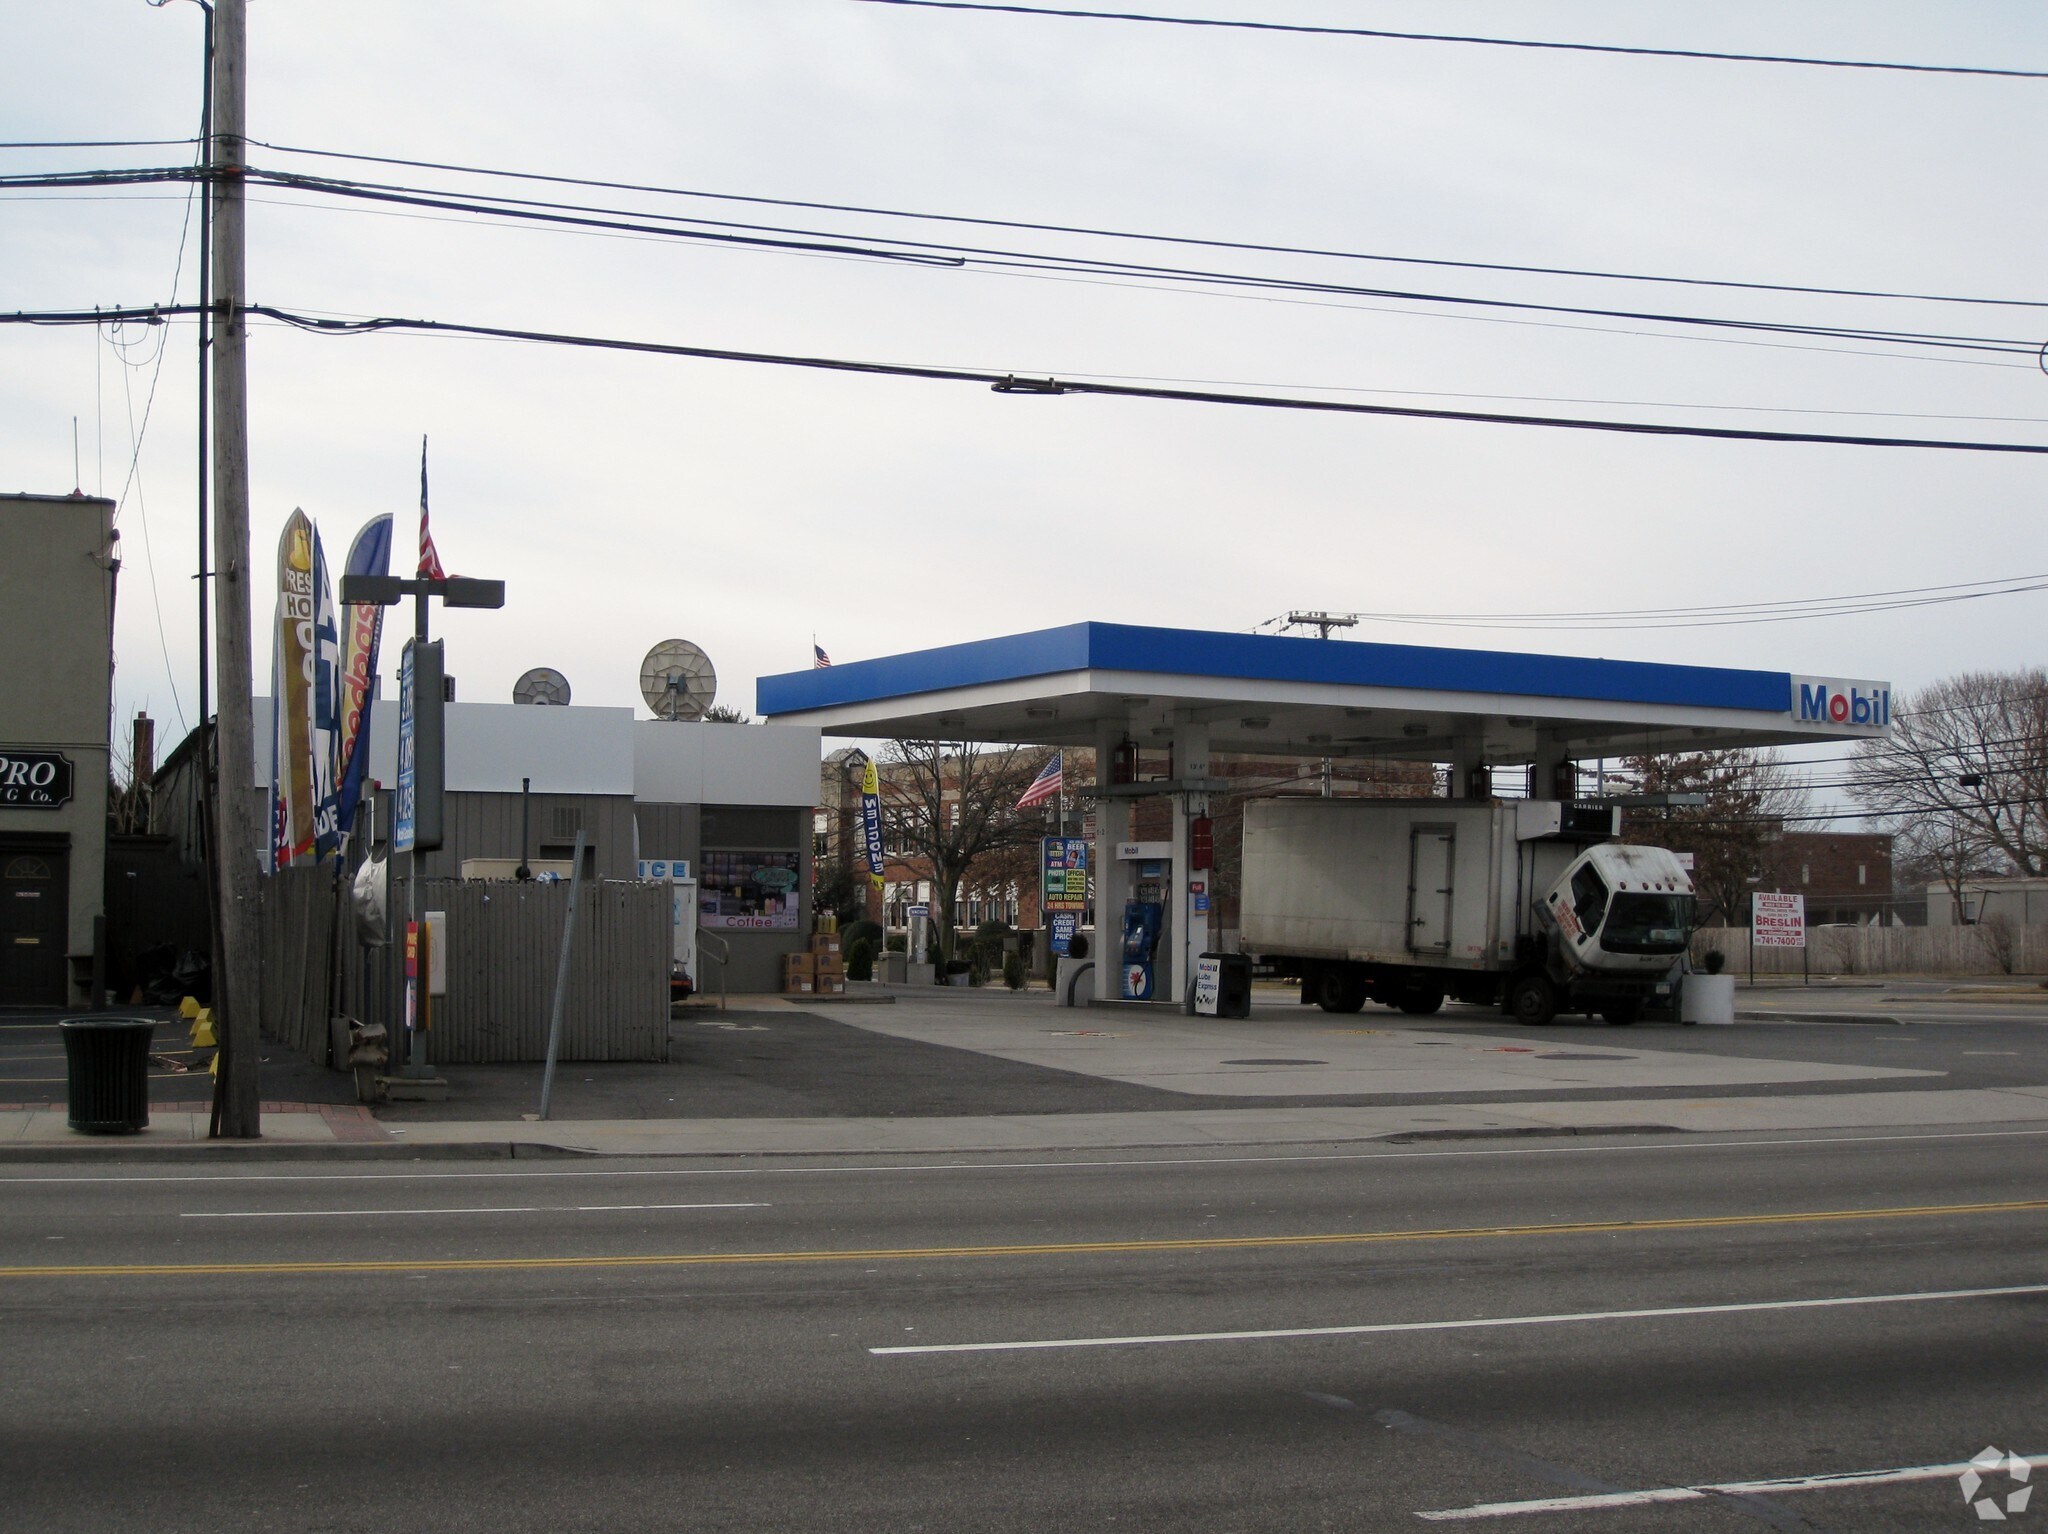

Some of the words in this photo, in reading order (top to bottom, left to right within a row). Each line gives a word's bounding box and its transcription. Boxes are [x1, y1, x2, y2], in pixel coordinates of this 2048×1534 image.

[286, 568, 312, 592] FRES
[287, 595, 312, 617] HO
[1800, 683, 1888, 725] Mobil
[0, 788, 19, 801] G
[30, 789, 52, 802] Co.
[1124, 847, 1139, 855] Mobil
[638, 861, 686, 878] ICE
[1758, 894, 1798, 902] AVAILABLE
[726, 916, 772, 927] Coffee
[1755, 915, 1801, 927] BRESLIN
[1761, 936, 1796, 945] 741-7400
[1200, 963, 1212, 971] Mobil
[1198, 972, 1211, 980] Lube
